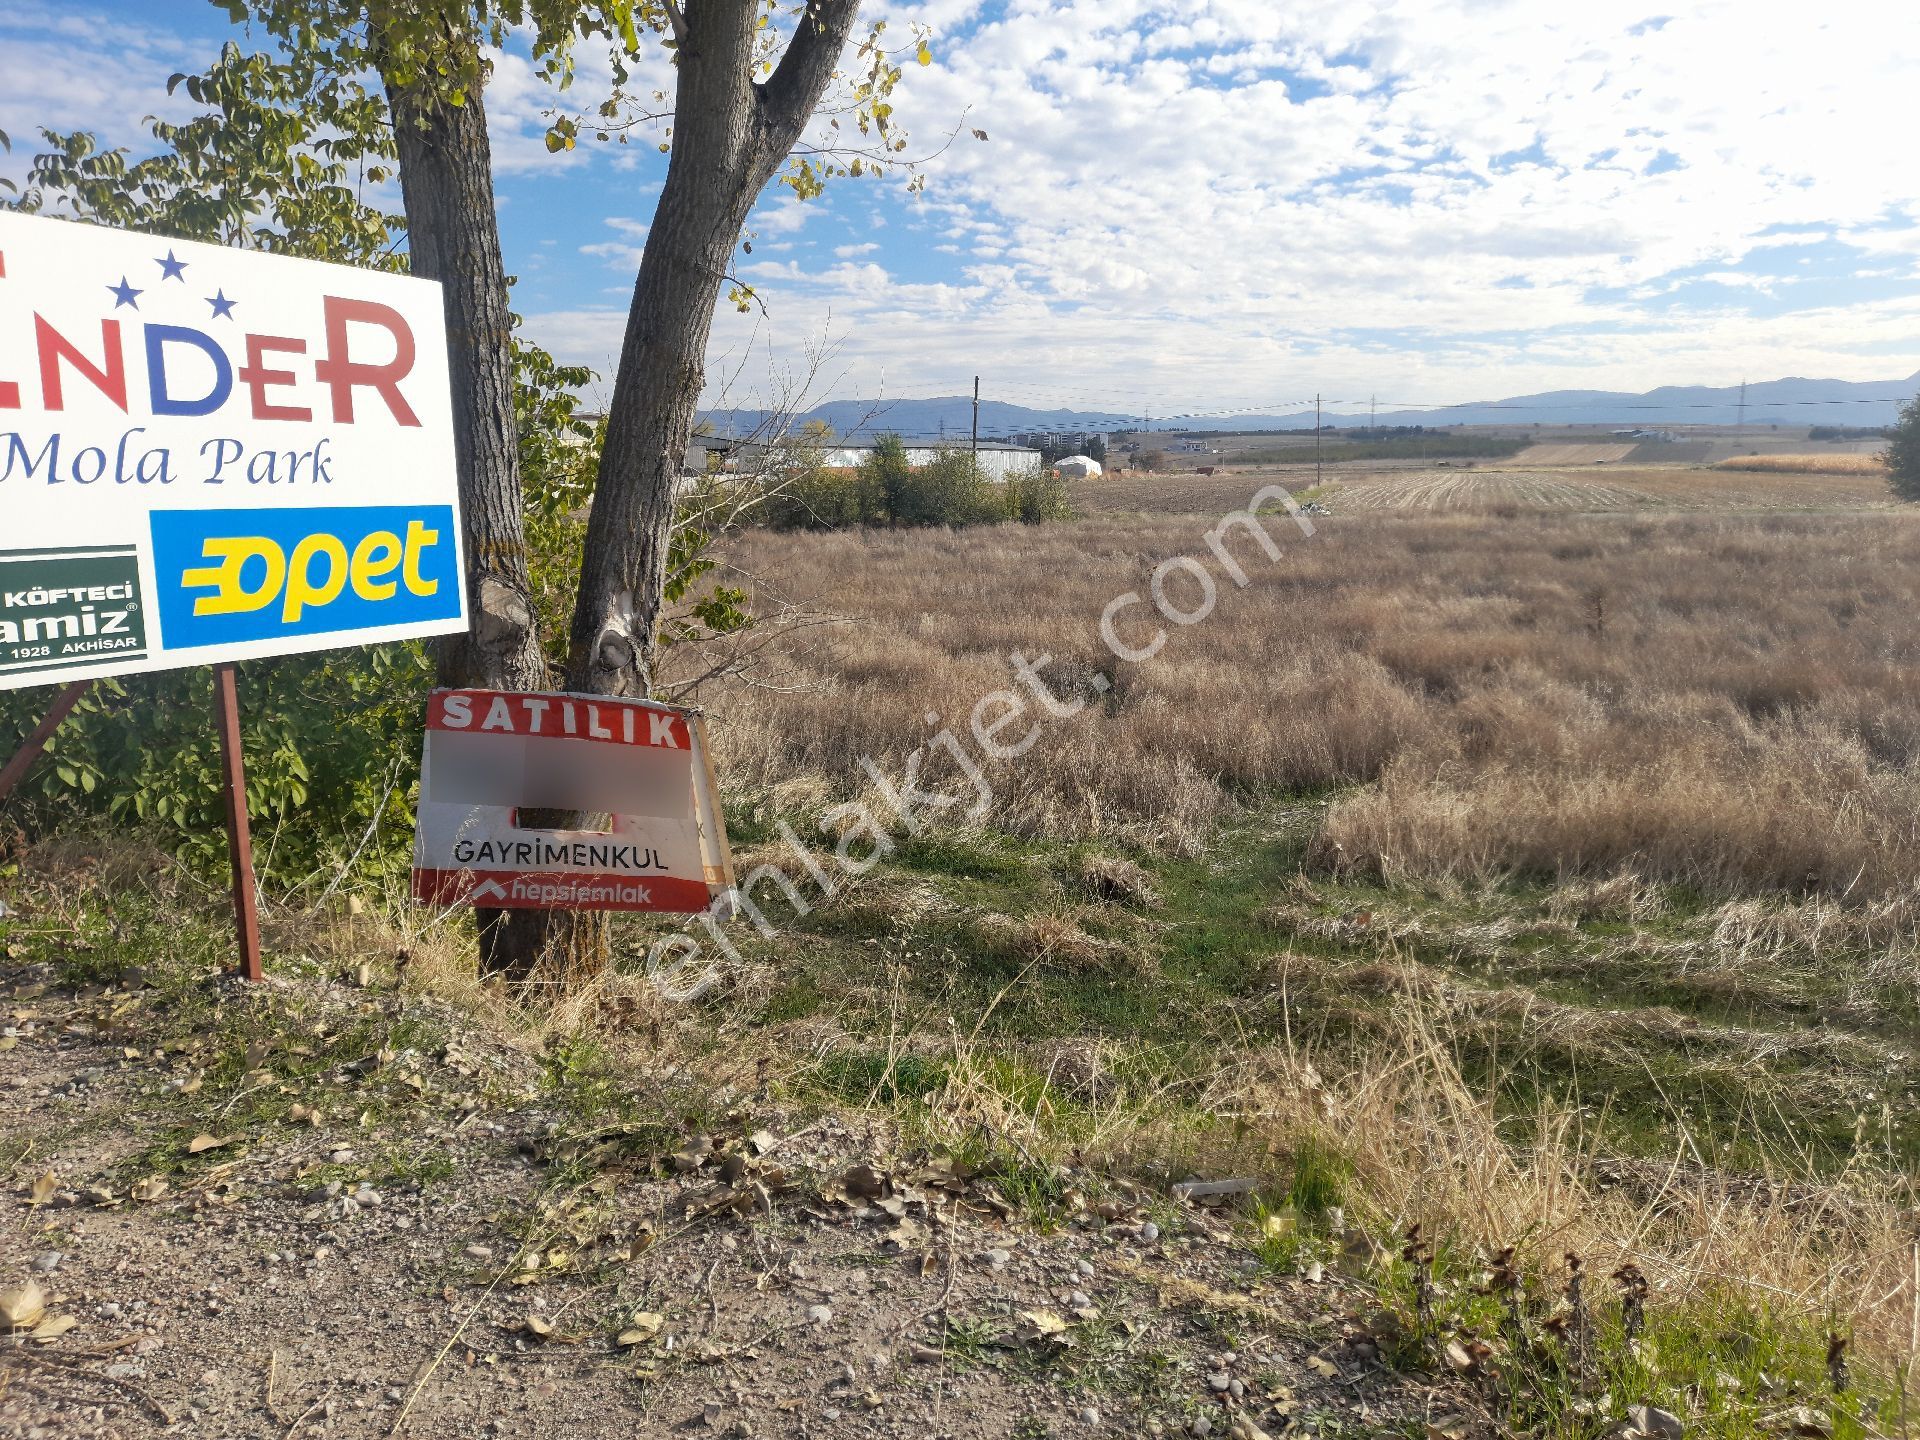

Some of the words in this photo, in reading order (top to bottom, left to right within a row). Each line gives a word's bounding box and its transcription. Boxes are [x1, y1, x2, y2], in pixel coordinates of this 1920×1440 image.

[0, 250, 423, 428] NDER
[0, 427, 178, 485] Mola
[199, 438, 334, 485] Park
[180, 520, 438, 623] opet
[4, 580, 133, 608] KÖFTECİ
[11, 646, 51, 659] 1928
[61, 637, 138, 654] AKHİSAR
[441, 696, 679, 749] SATILIK
[454, 837, 669, 871] GAYRİMENKUL
[511, 878, 652, 906] hepsiemlak
